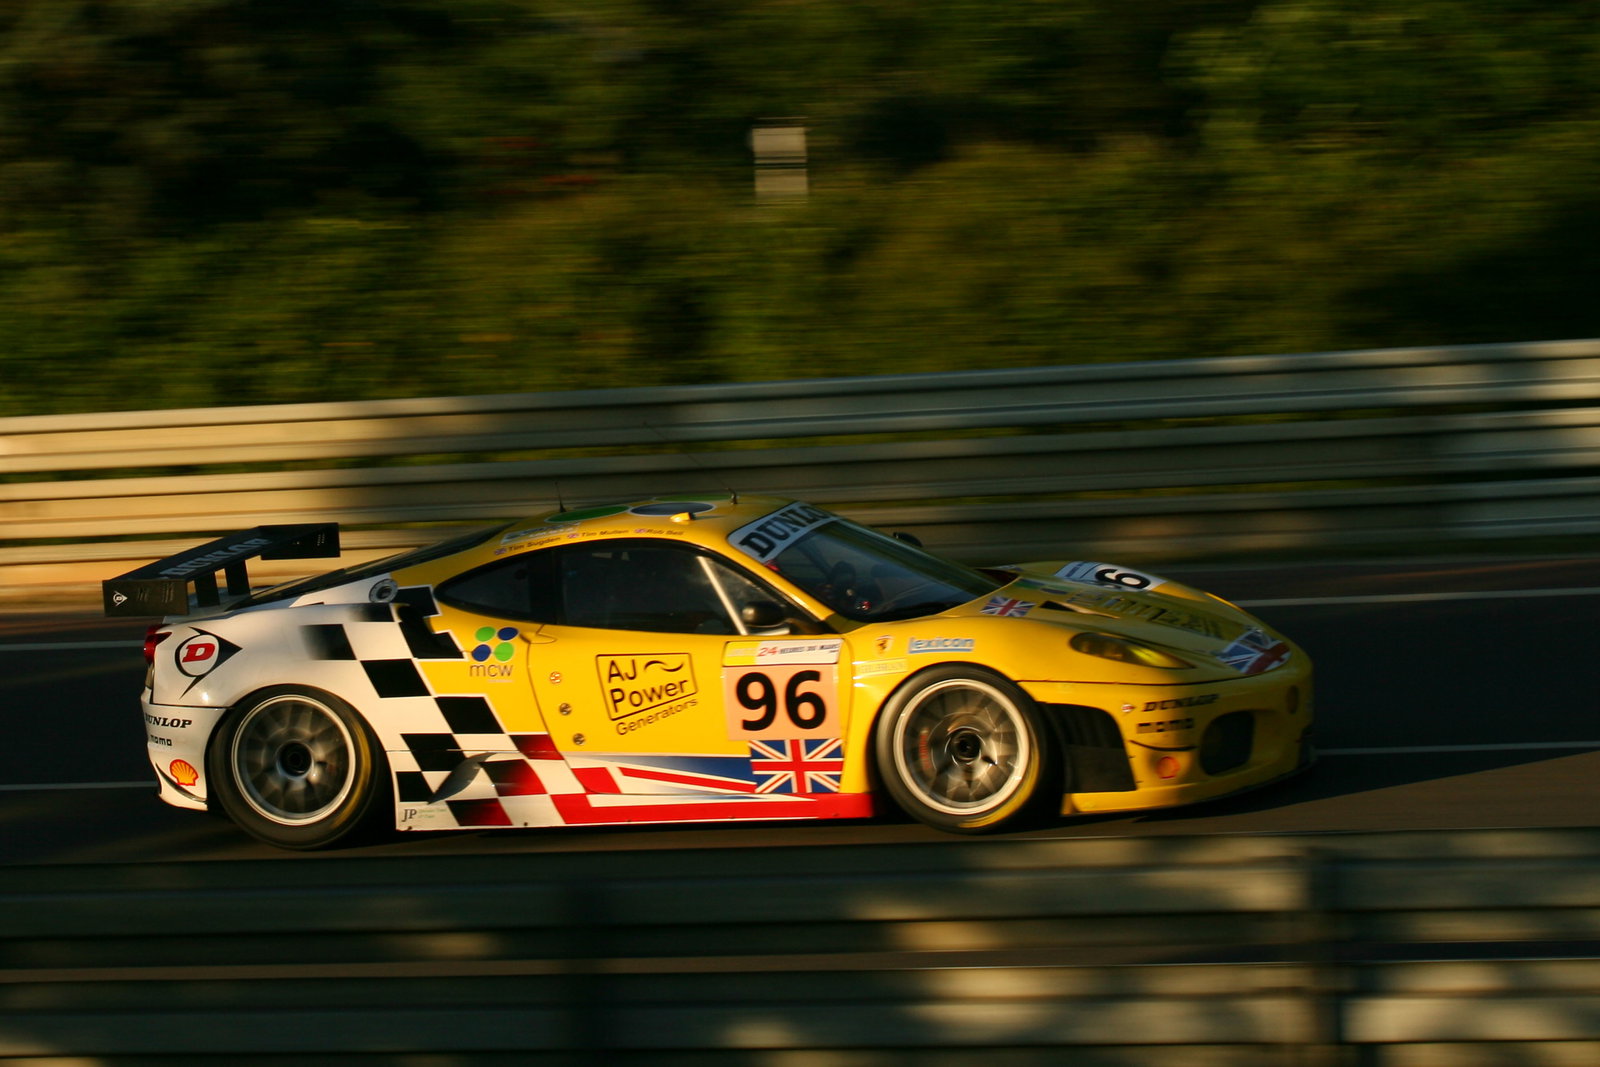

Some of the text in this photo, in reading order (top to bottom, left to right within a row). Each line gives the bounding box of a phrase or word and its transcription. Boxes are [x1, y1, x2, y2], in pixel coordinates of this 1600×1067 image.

[738, 506, 834, 559] DUNLO
[508, 537, 561, 552] Tim Sugden
[158, 537, 273, 576] DUNLOP
[182, 642, 216, 662] D
[757, 645, 777, 656] 24
[908, 637, 975, 649] lexicon
[469, 664, 513, 677] mcw
[607, 659, 638, 684] AJ
[609, 679, 689, 713] Power
[735, 669, 827, 732] 96
[1142, 694, 1218, 712] DUNLOP
[615, 698, 698, 736] Generators
[401, 808, 418, 823] JP
